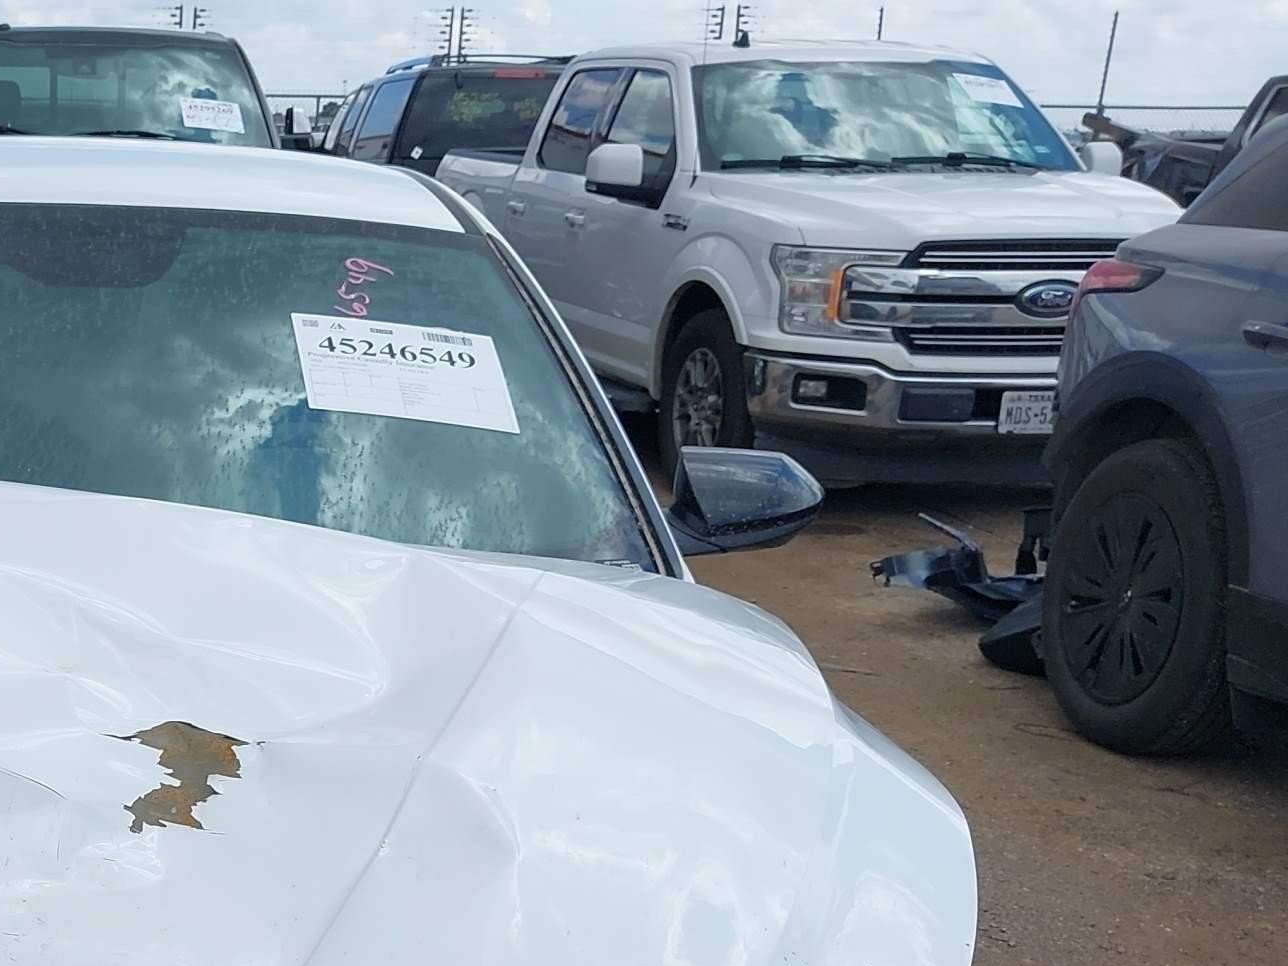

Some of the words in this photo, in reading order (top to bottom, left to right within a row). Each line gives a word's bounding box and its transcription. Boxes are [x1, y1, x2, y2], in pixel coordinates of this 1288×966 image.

[334, 256, 394, 317] 6549
[1037, 290, 1072, 307] Ford
[318, 335, 476, 369] 45246549
[1004, 406, 1055, 425] MDS-5
